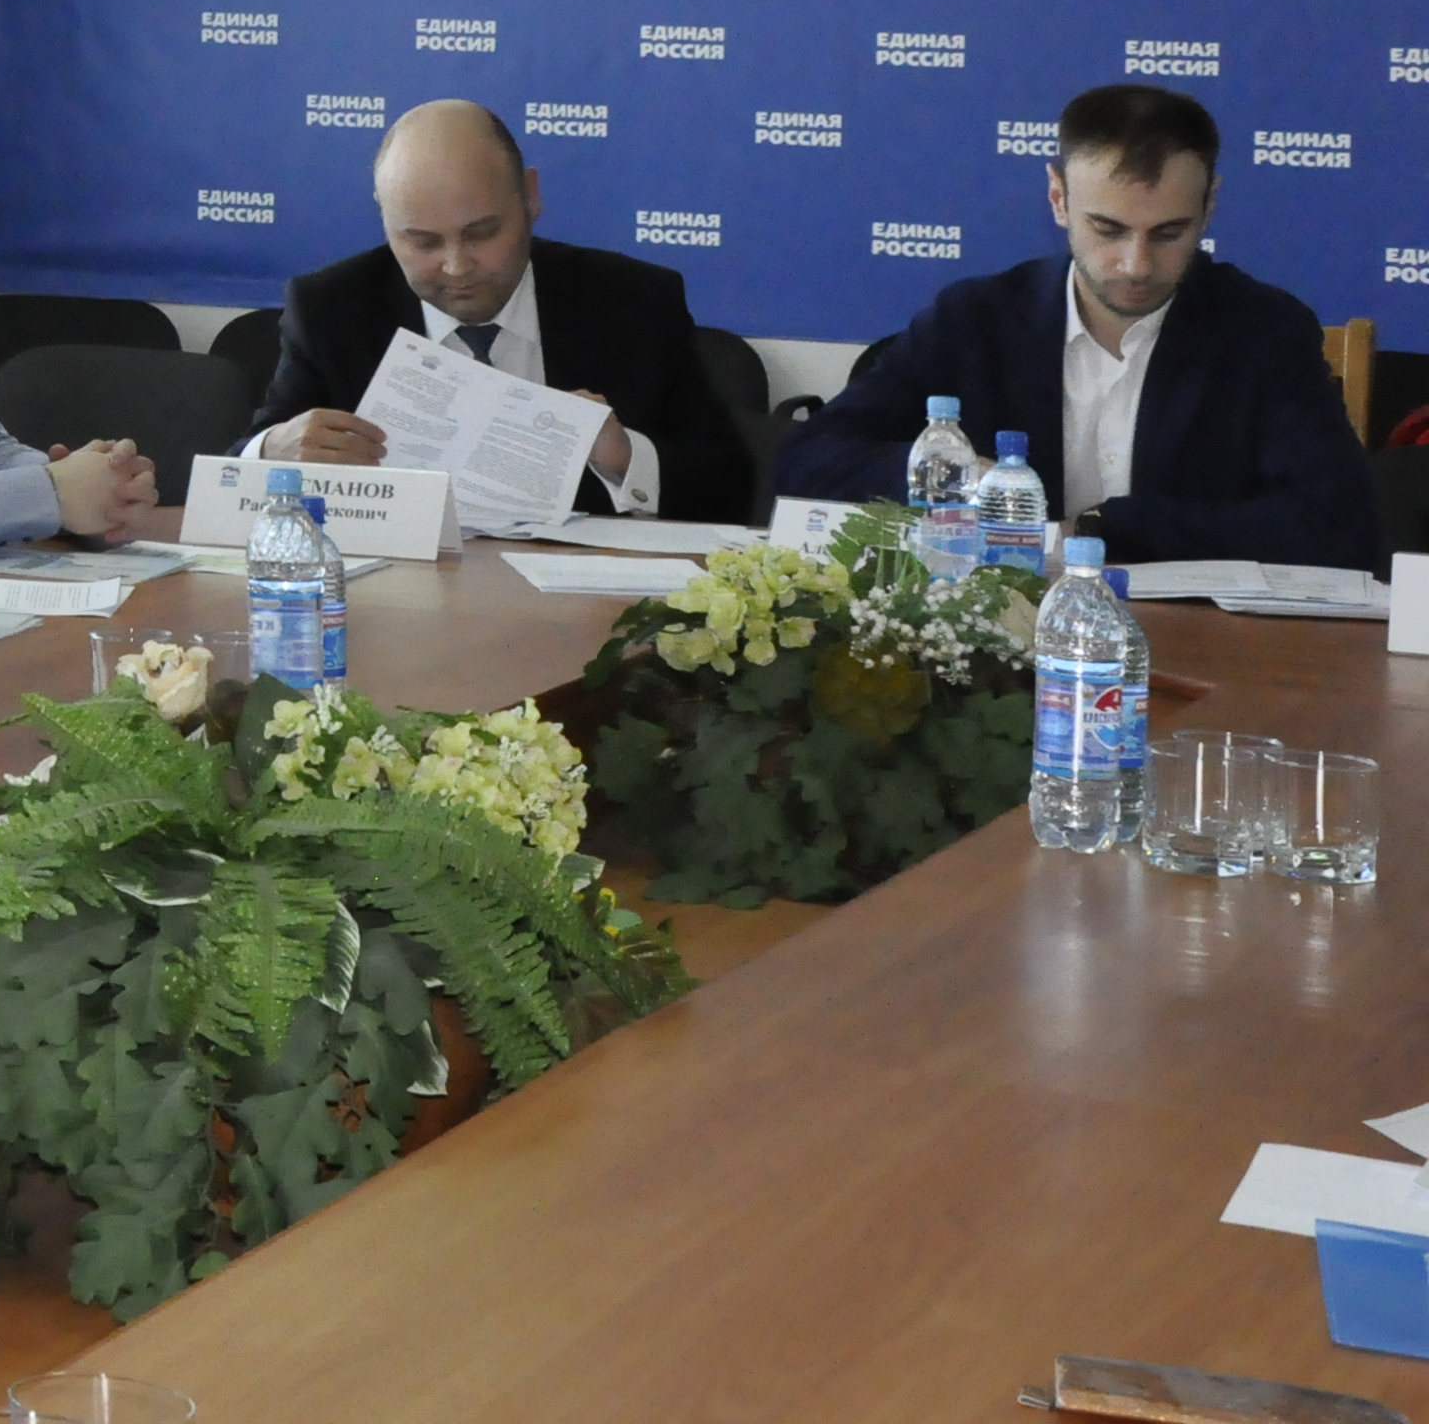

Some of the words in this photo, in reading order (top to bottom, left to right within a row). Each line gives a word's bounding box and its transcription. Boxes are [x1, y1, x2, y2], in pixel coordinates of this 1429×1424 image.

[201, 11, 279, 28] ЕДИНАЯ
[415, 18, 497, 35] ЕДИНАЯ
[200, 27, 279, 46] РОССИЯ
[639, 24, 726, 42] ЕДИНАЯ
[876, 31, 966, 50] ЕДИНАЯ
[415, 34, 497, 53] РОССИЯ
[639, 41, 726, 60] РОССИЯ
[1124, 39, 1221, 58] ЕДИНАЯ
[875, 49, 966, 69] РОССИЯ
[1124, 57, 1220, 77] РОССИЯ
[306, 94, 386, 111] ЕДИНАЯ
[525, 102, 609, 120] ЕДИНАЯ
[305, 110, 385, 129] РОССИЯ
[524, 119, 608, 138] РОССИЯ
[754, 111, 843, 129] ЕДИНАЯ
[754, 128, 843, 148] РОССИЯ
[997, 121, 1061, 139] ЕДИН
[996, 138, 1061, 157] РОСС
[1253, 130, 1352, 150] ЕДИНАЯ
[1252, 148, 1352, 169] РОССИЯ
[197, 189, 276, 207] ЕДИНАЯ
[196, 205, 275, 224] РОССИЯ
[635, 209, 722, 228] ЕДИНАЯ
[635, 227, 722, 247] РОССИЯ
[871, 221, 962, 241] ЕДИНАЯ
[870, 239, 962, 260] РОССИЯ
[1384, 247, 1429, 266] ЕДИ
[1384, 265, 1429, 285] РОС
[301, 477, 395, 500] СМАНОВ
[324, 506, 388, 521] скович
